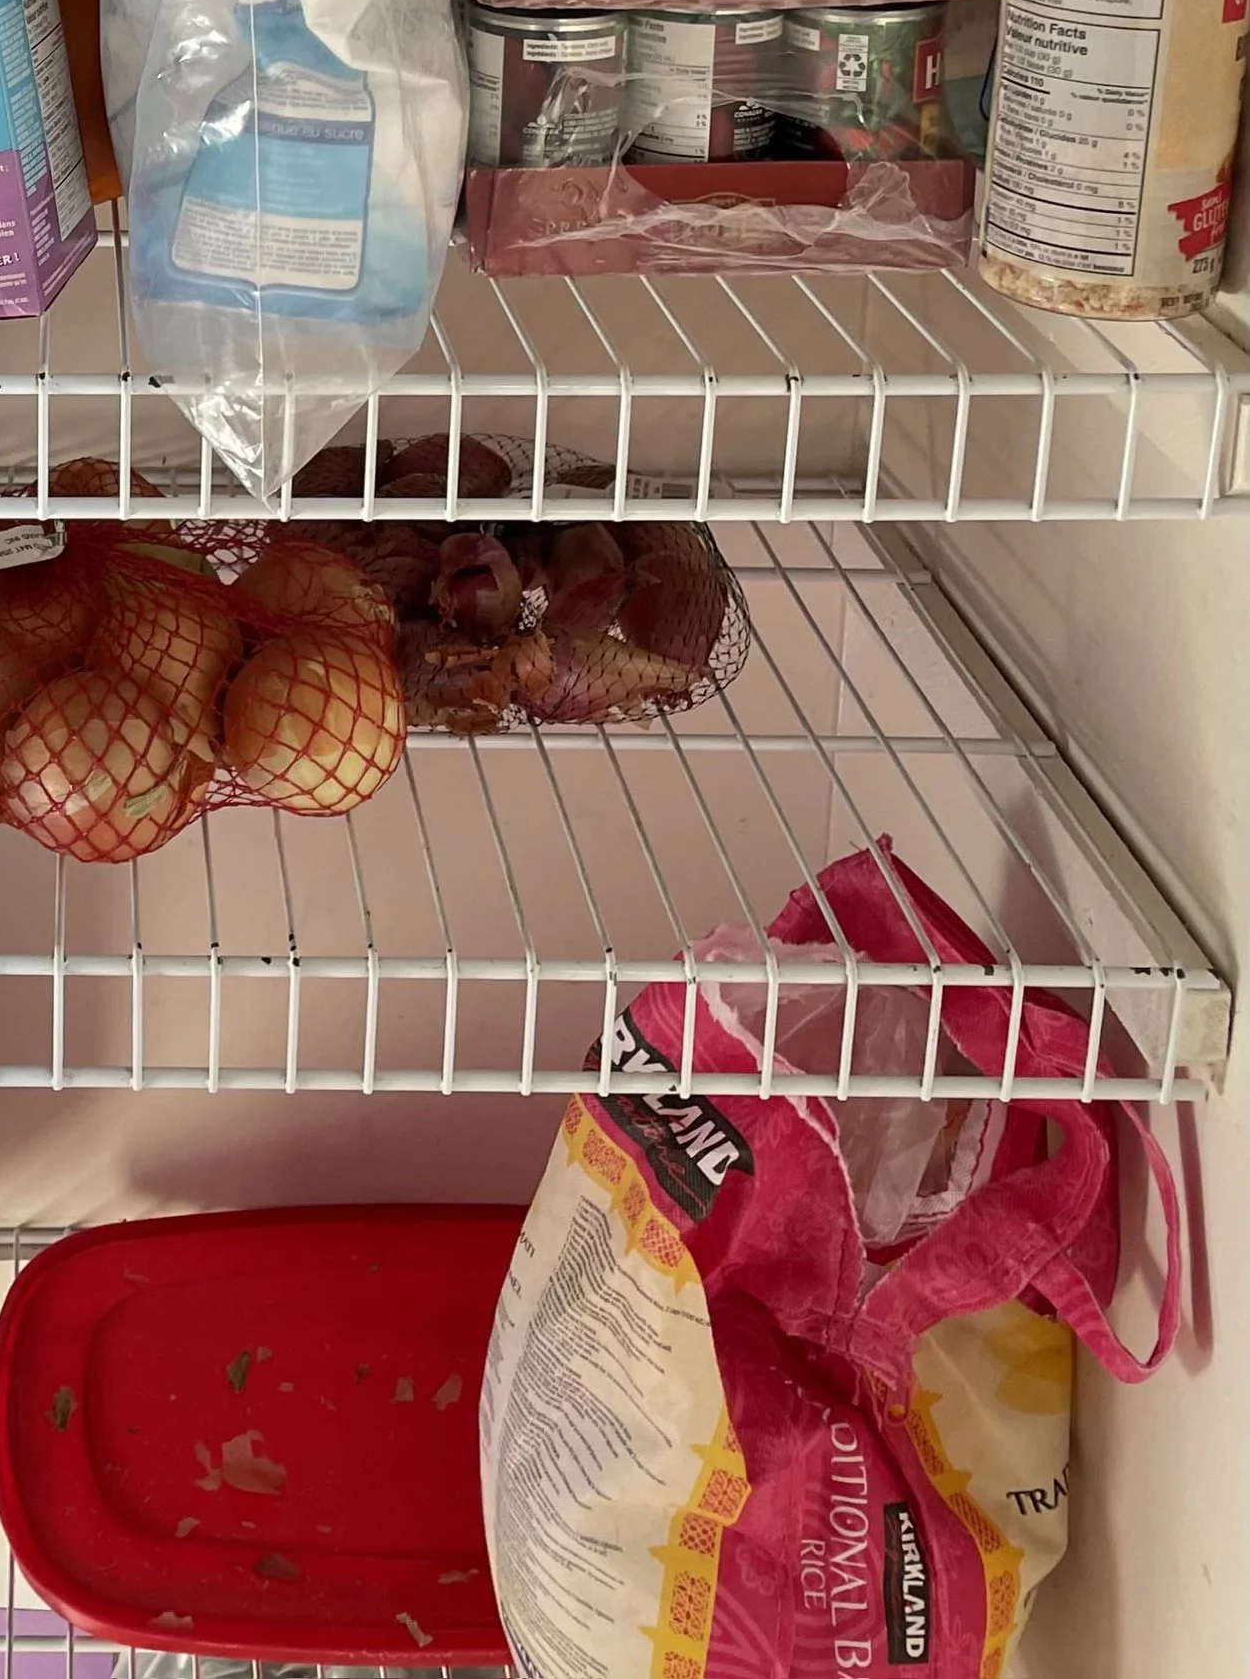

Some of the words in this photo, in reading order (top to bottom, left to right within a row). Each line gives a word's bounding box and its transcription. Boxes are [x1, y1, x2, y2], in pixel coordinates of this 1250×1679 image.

[1006, 8, 1046, 33] Nutrition
[1049, 22, 1087, 41] Facts
[1006, 24, 1033, 46] Valeur
[1034, 37, 1089, 57] nutritive
[925, 52, 941, 90] H
[325, 127, 365, 140] sucre
[800, 1538, 827, 1610] RICE
[898, 1511, 927, 1659] KIRKLAND
